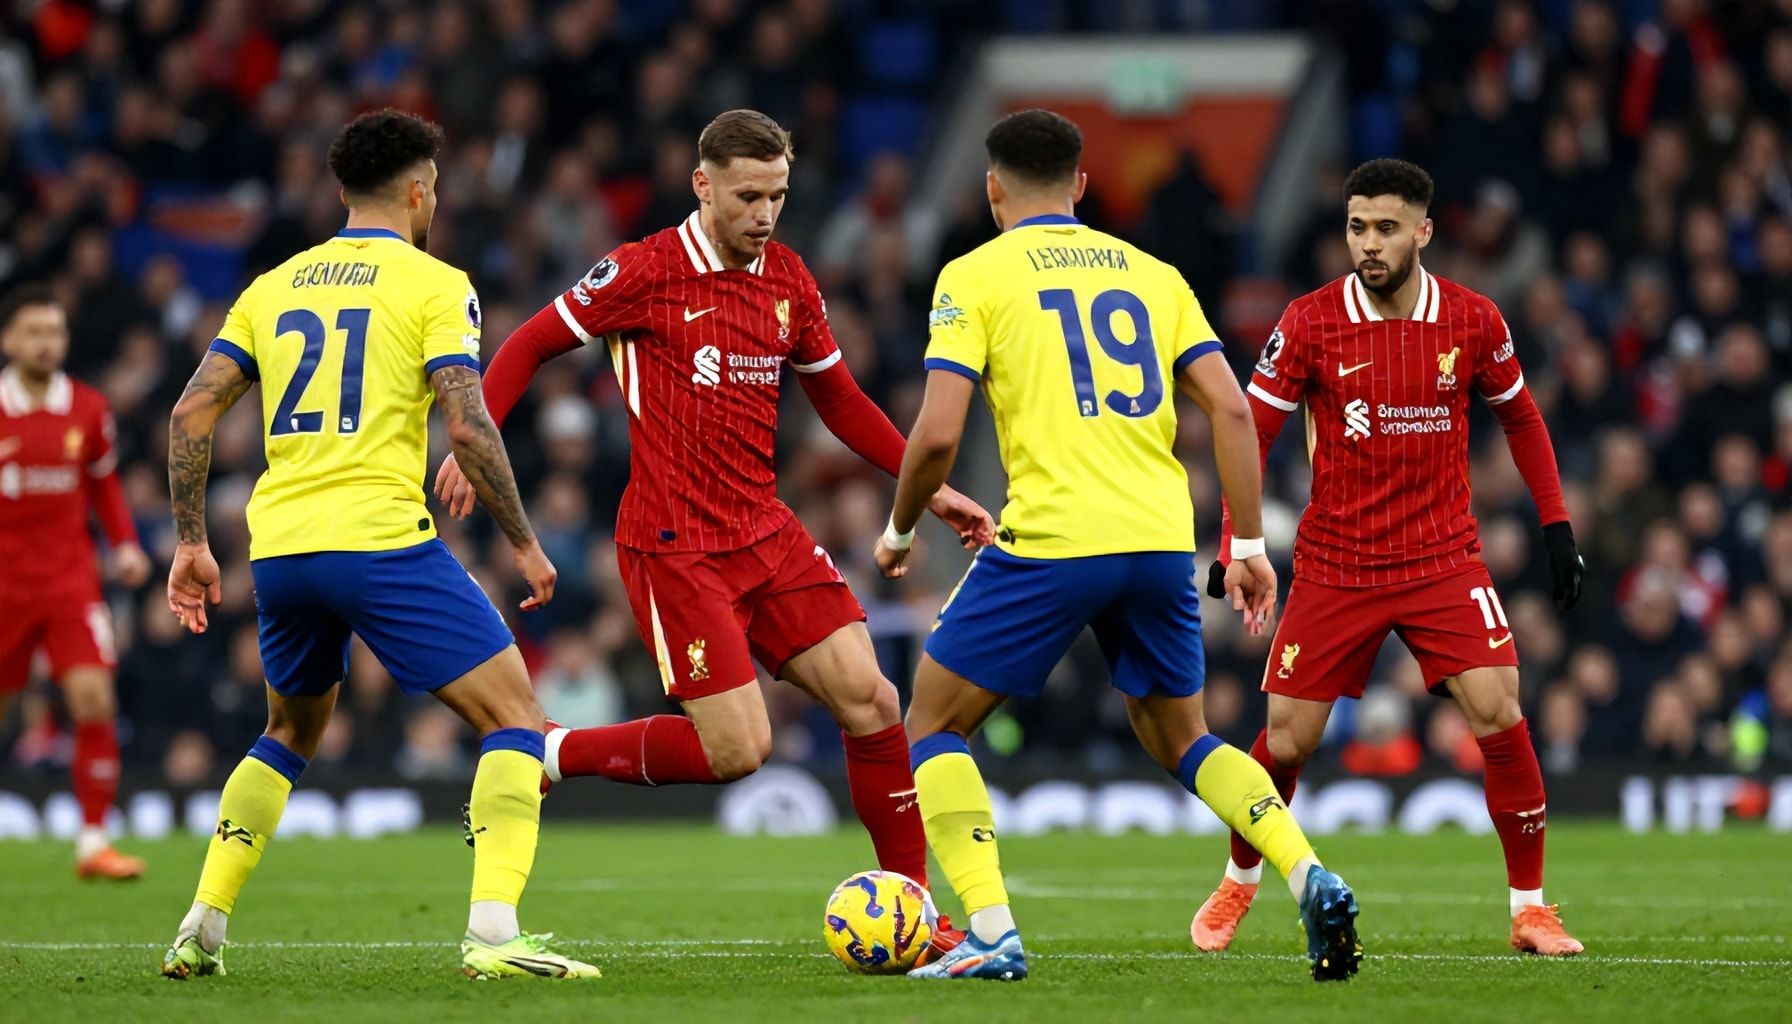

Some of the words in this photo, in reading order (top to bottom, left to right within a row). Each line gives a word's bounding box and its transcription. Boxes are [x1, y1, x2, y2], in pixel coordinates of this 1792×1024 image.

[269, 308, 371, 438] 21
[1038, 288, 1164, 418] 19
[1470, 586, 1509, 630] 11
